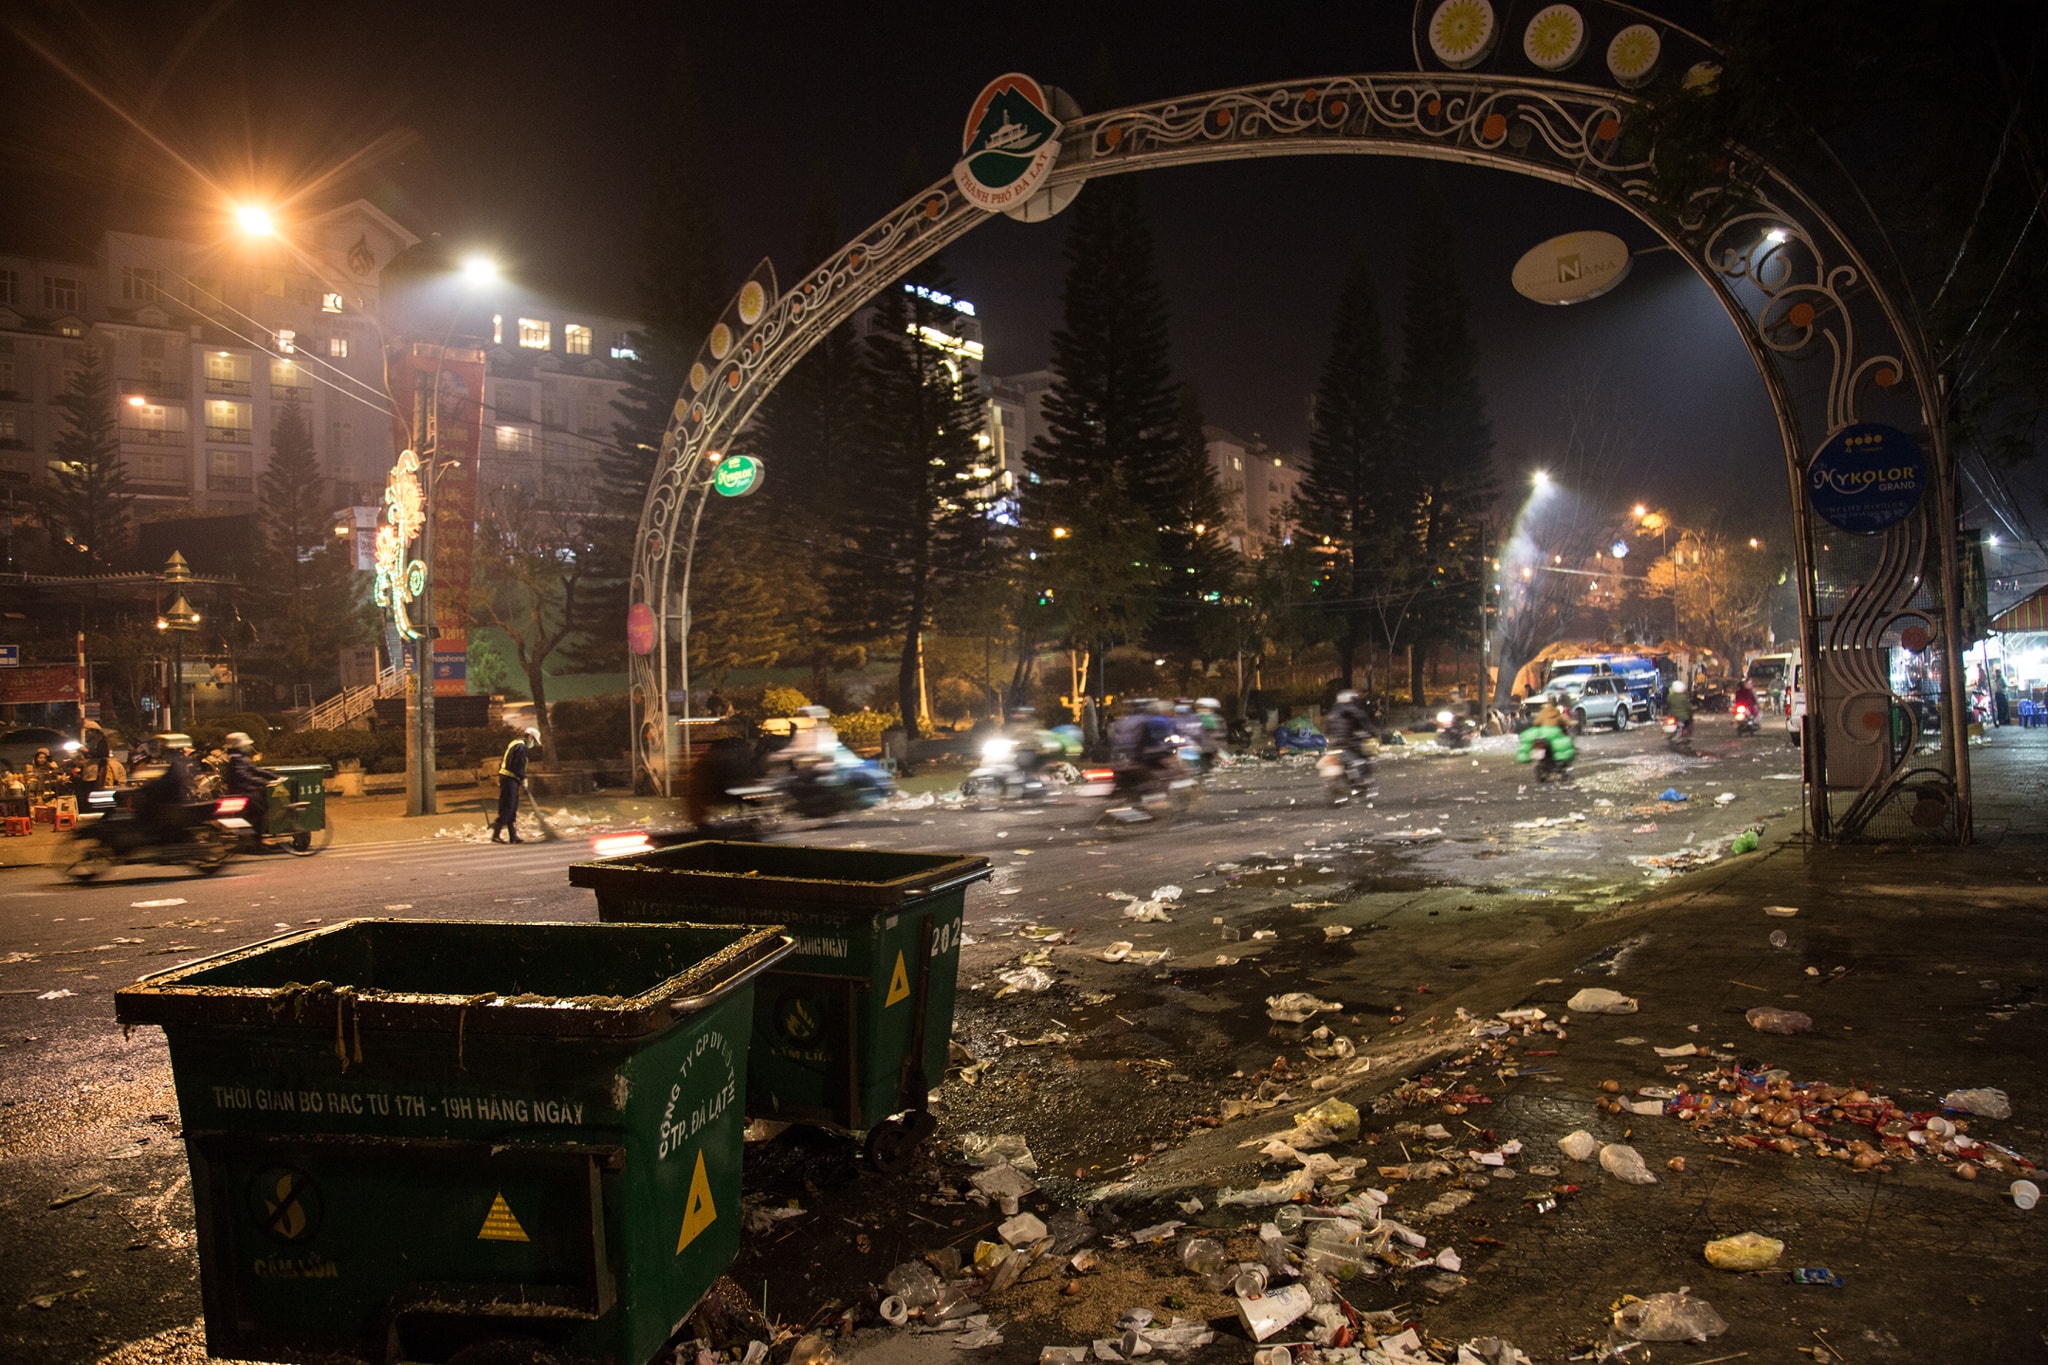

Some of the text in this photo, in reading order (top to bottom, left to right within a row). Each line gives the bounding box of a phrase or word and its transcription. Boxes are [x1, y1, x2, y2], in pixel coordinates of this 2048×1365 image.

[1878, 481, 1916, 492] GRAND
[931, 916, 961, 957] 202
[680, 1050, 694, 1078] TY
[695, 1033, 709, 1057] CP
[710, 1031, 723, 1050] DV
[255, 1088, 296, 1112] GIAN
[396, 1095, 427, 1118] 17H
[441, 1096, 473, 1120] 19H
[670, 1120, 688, 1151] TP.
[709, 1086, 728, 1120] LẠT
